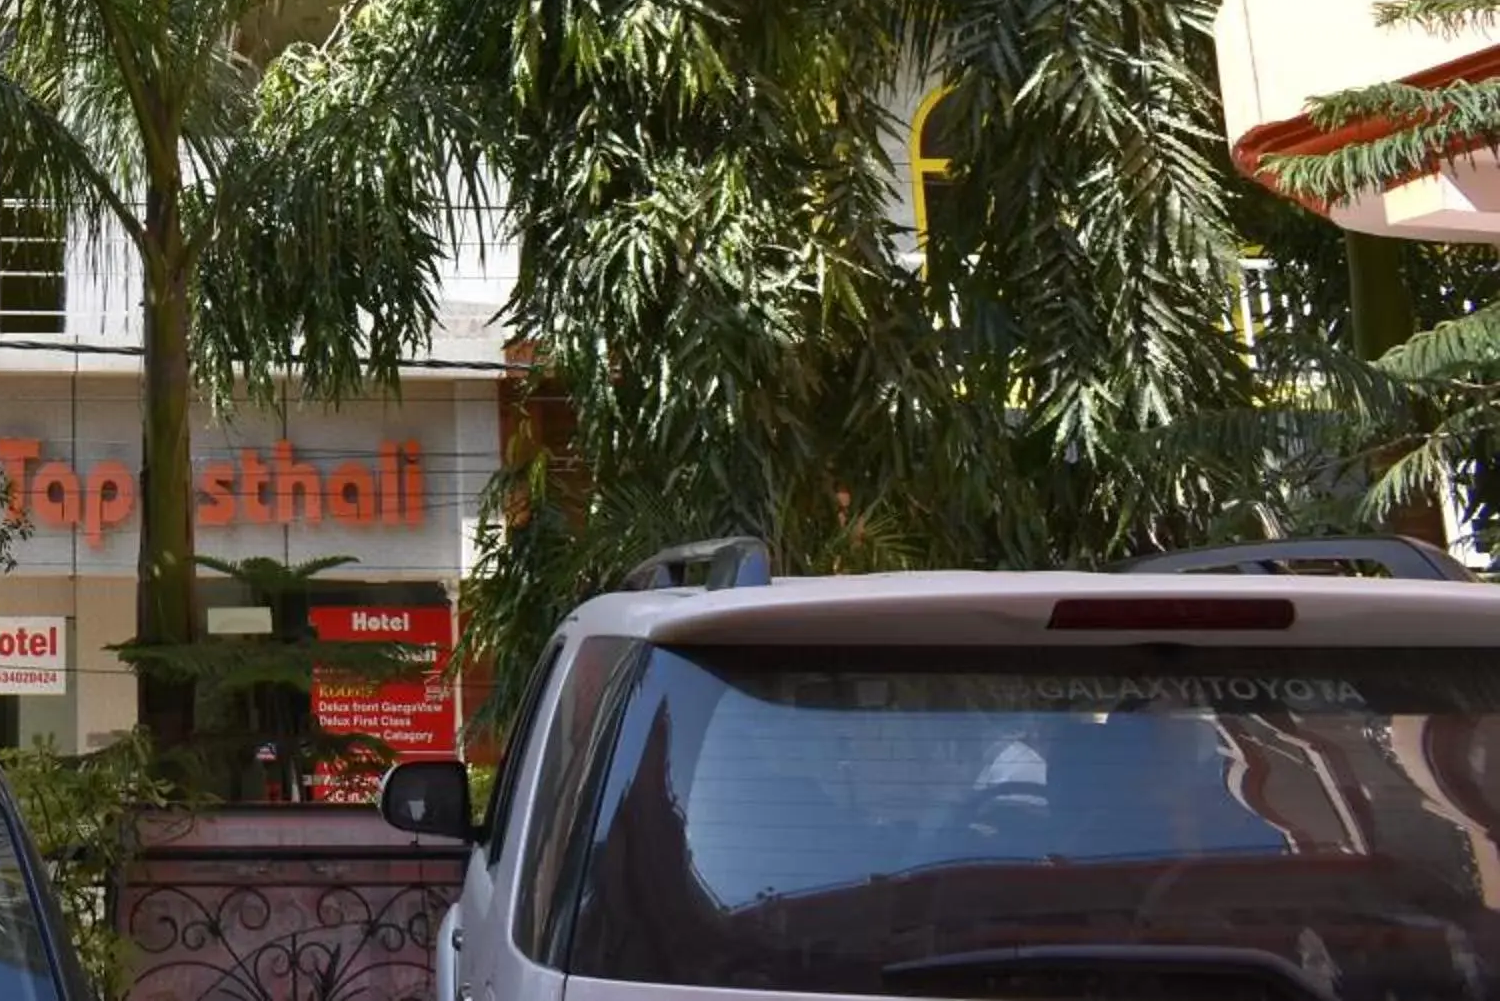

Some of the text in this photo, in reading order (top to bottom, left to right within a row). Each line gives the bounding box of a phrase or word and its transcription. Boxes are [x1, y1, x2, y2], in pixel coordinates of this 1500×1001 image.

[352, 611, 409, 631] Hotel
[1035, 675, 1368, 704] GALAXY TOYOTA
[319, 701, 350, 712] Delux
[319, 715, 411, 727] Delux First Class
